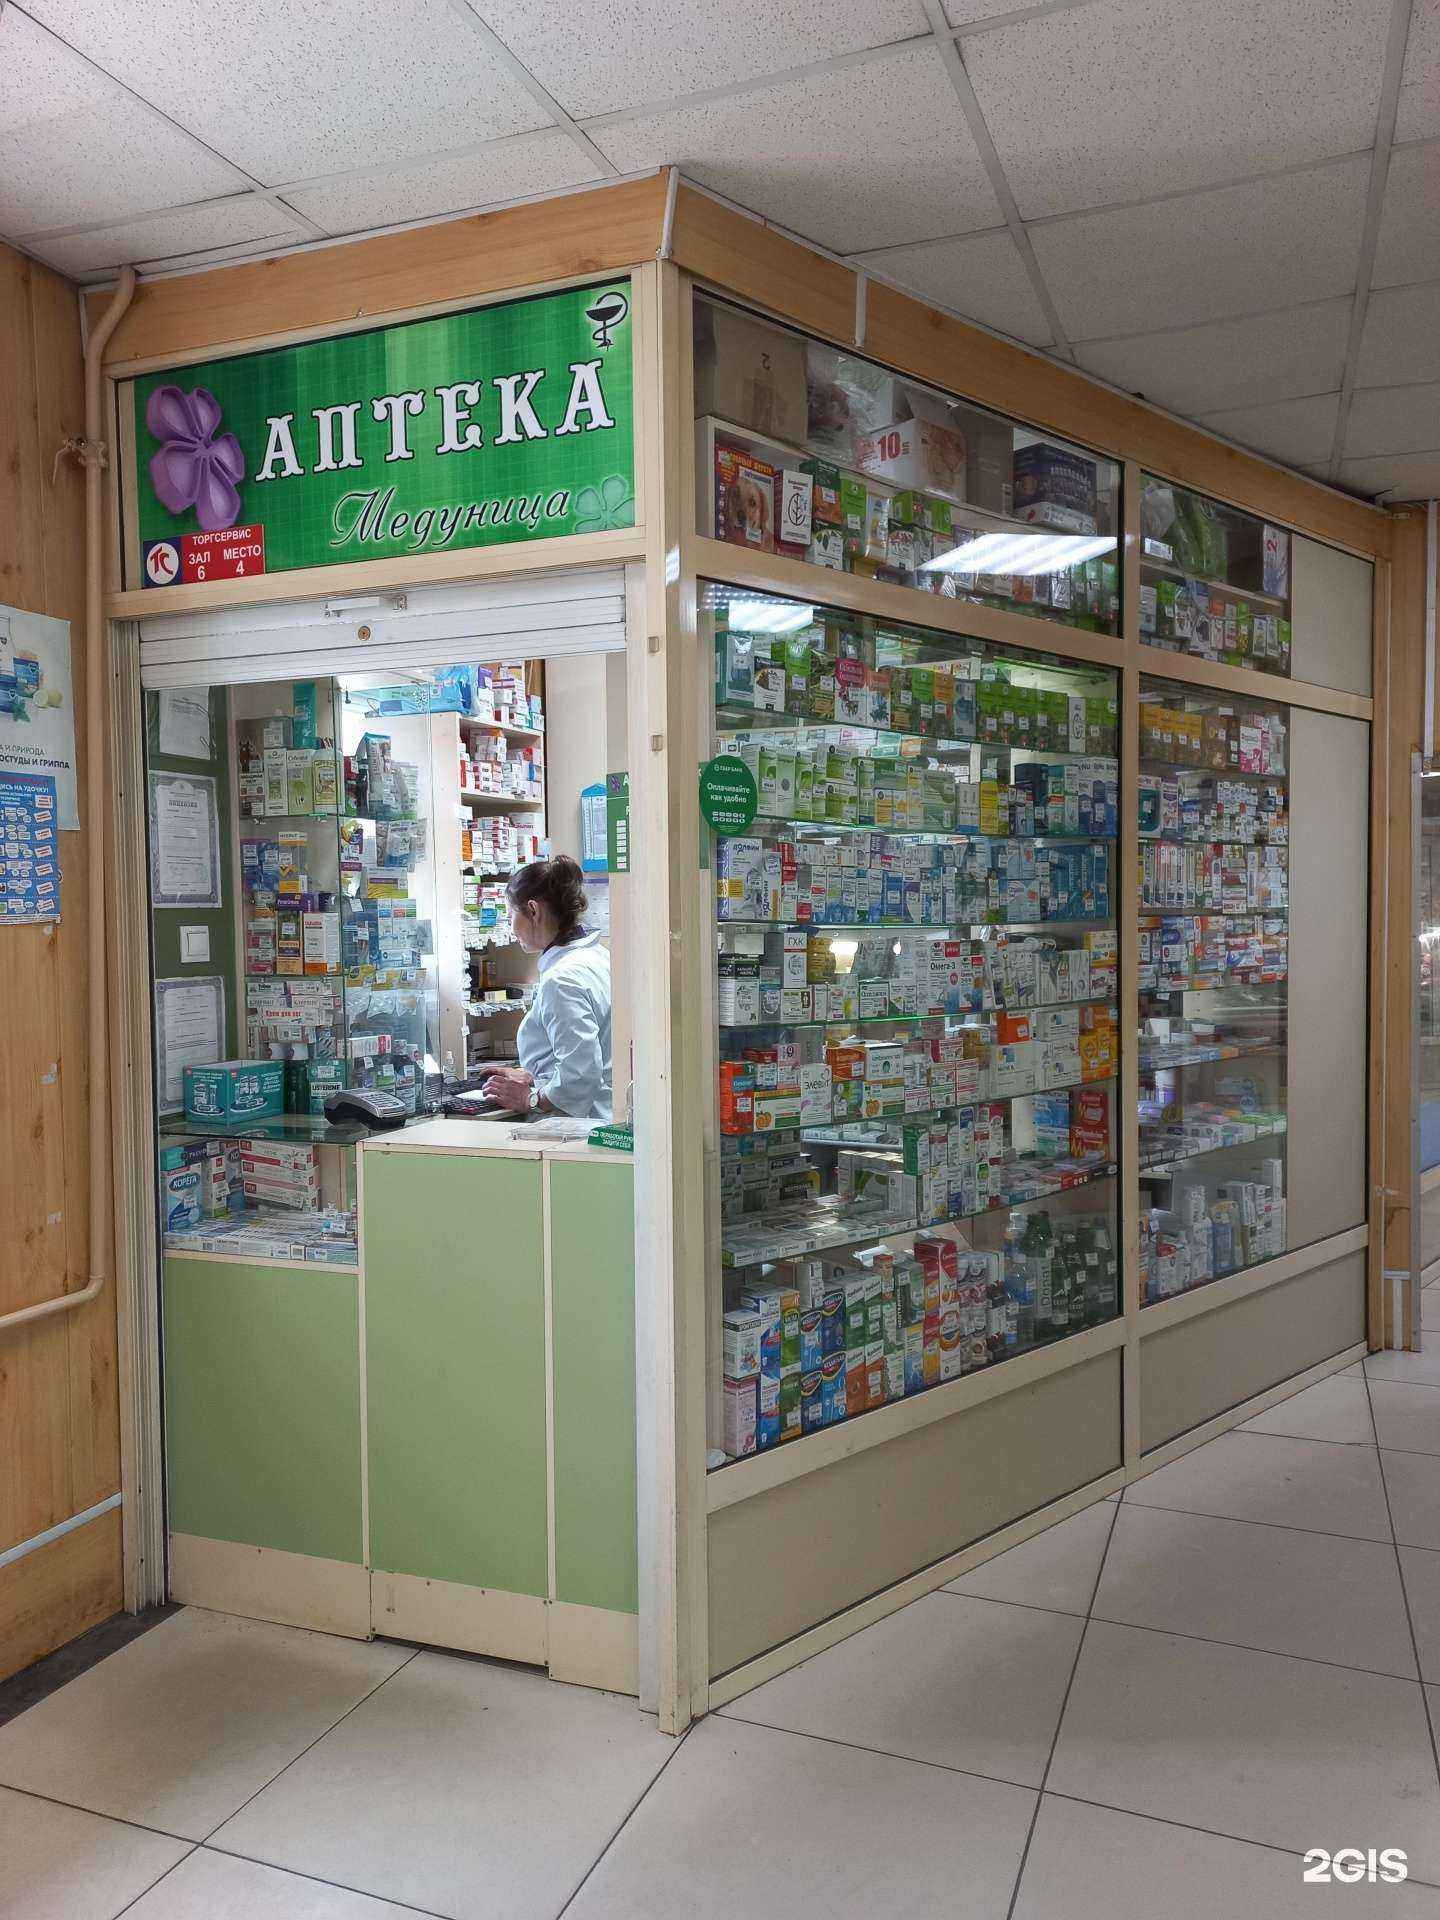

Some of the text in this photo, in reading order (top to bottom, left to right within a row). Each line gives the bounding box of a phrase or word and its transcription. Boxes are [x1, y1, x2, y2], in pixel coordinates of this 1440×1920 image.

[255, 358, 616, 482] АПТЕКА
[877, 431, 901, 462] 10
[330, 487, 569, 550] Медуница
[192, 528, 251, 546] ТОРГСЕРВИС
[189, 545, 261, 565] ЗАЛ МЕСТО
[197, 560, 245, 580] 6 4
[32, 758, 38, 766] И
[40, 759, 70, 769] ГРИППА
[707, 782, 750, 793] Оплачивайте
[723, 794, 747, 804] удобно
[173, 1174, 198, 1189] КОРЕГА
